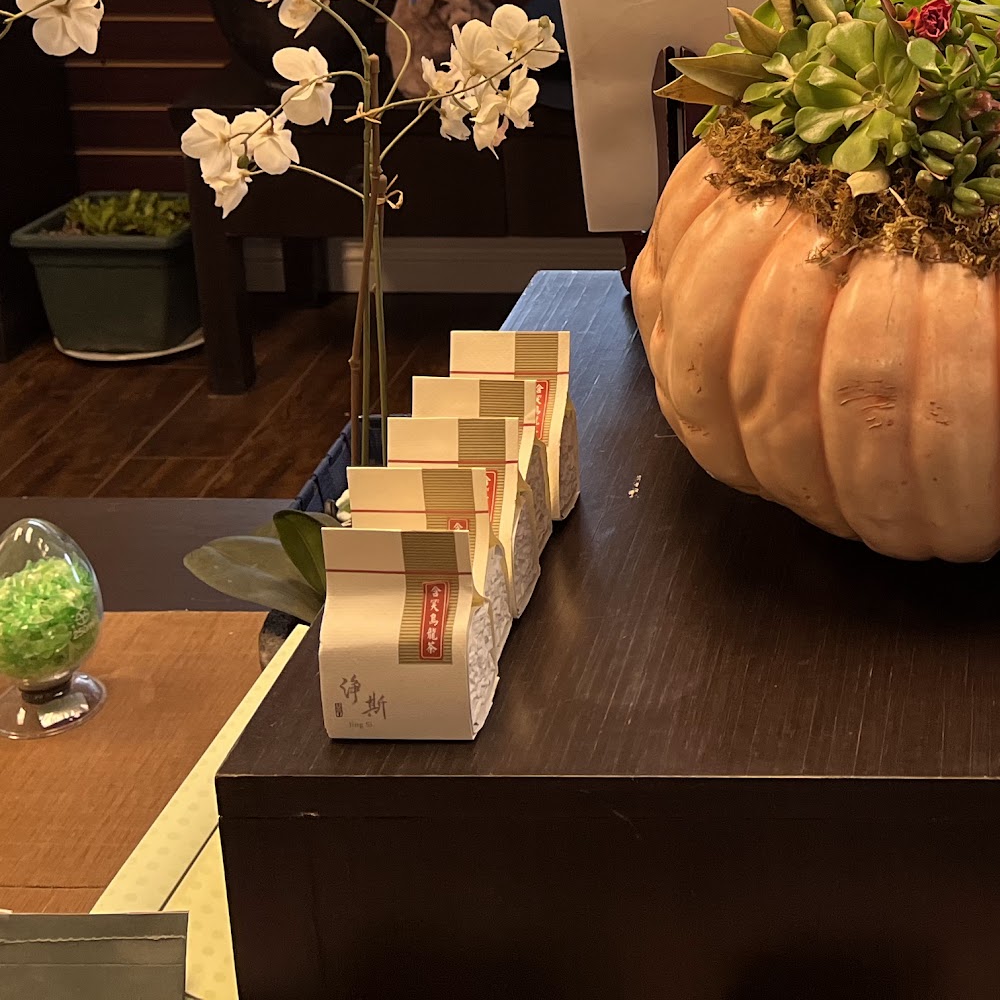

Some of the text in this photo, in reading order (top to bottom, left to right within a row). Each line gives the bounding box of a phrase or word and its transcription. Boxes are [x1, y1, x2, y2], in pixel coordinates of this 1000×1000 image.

[426, 585, 442, 654] 含笑烏龍茶
